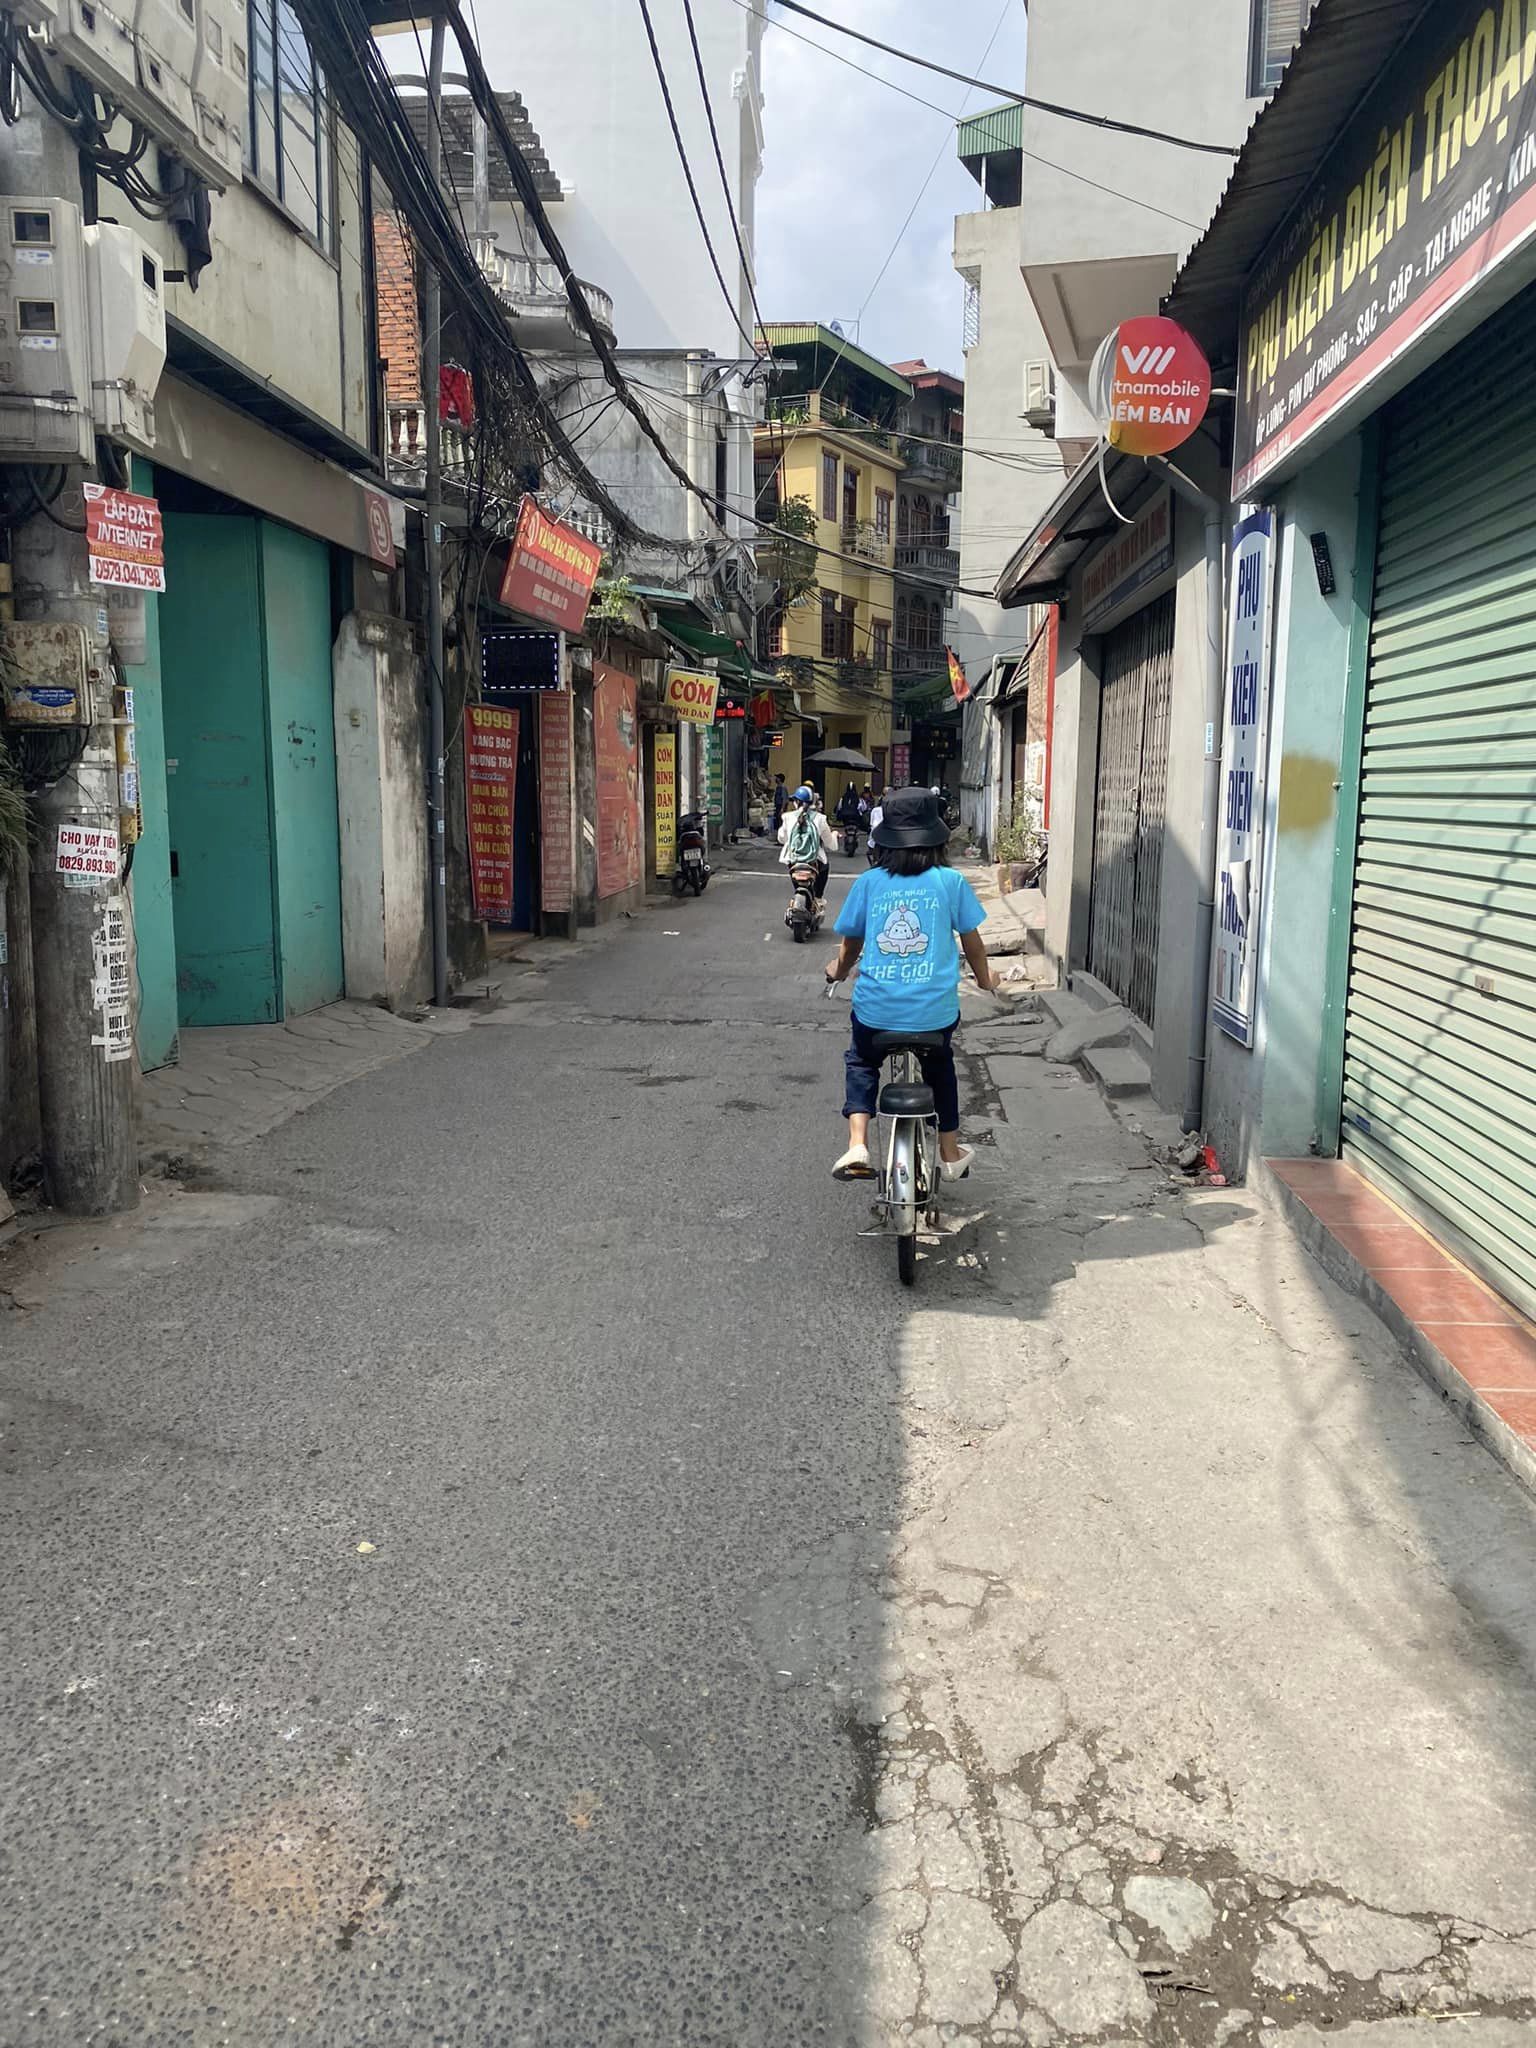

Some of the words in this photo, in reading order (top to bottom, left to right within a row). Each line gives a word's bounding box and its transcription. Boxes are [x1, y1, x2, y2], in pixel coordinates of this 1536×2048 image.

[1246, 289, 1282, 403] PHỤ
[1284, 213, 1338, 361] KIỆN
[1341, 112, 1413, 294] ĐIỆN
[1287, 378, 1302, 415] PIN
[1315, 331, 1348, 386] PHÒNG
[1355, 299, 1378, 346] SẠC
[1387, 262, 1412, 316] CÁP
[1425, 229, 1446, 280] TAI
[1449, 175, 1493, 252] NGHE
[1113, 379, 1201, 397] tnamobile
[1149, 402, 1191, 424] BÁN
[97, 521, 157, 550] INTERNET
[1236, 550, 1261, 631] PHỤ
[670, 678, 715, 706] CƠM
[1230, 649, 1258, 740] KIỆN
[473, 708, 513, 730] 9999
[1226, 757, 1254, 844] ĐIỆN
[60, 831, 82, 845] CHO
[84, 834, 101, 847] VAY
[58, 854, 117, 875] 0829.893.983
[922, 897, 940, 910] TA
